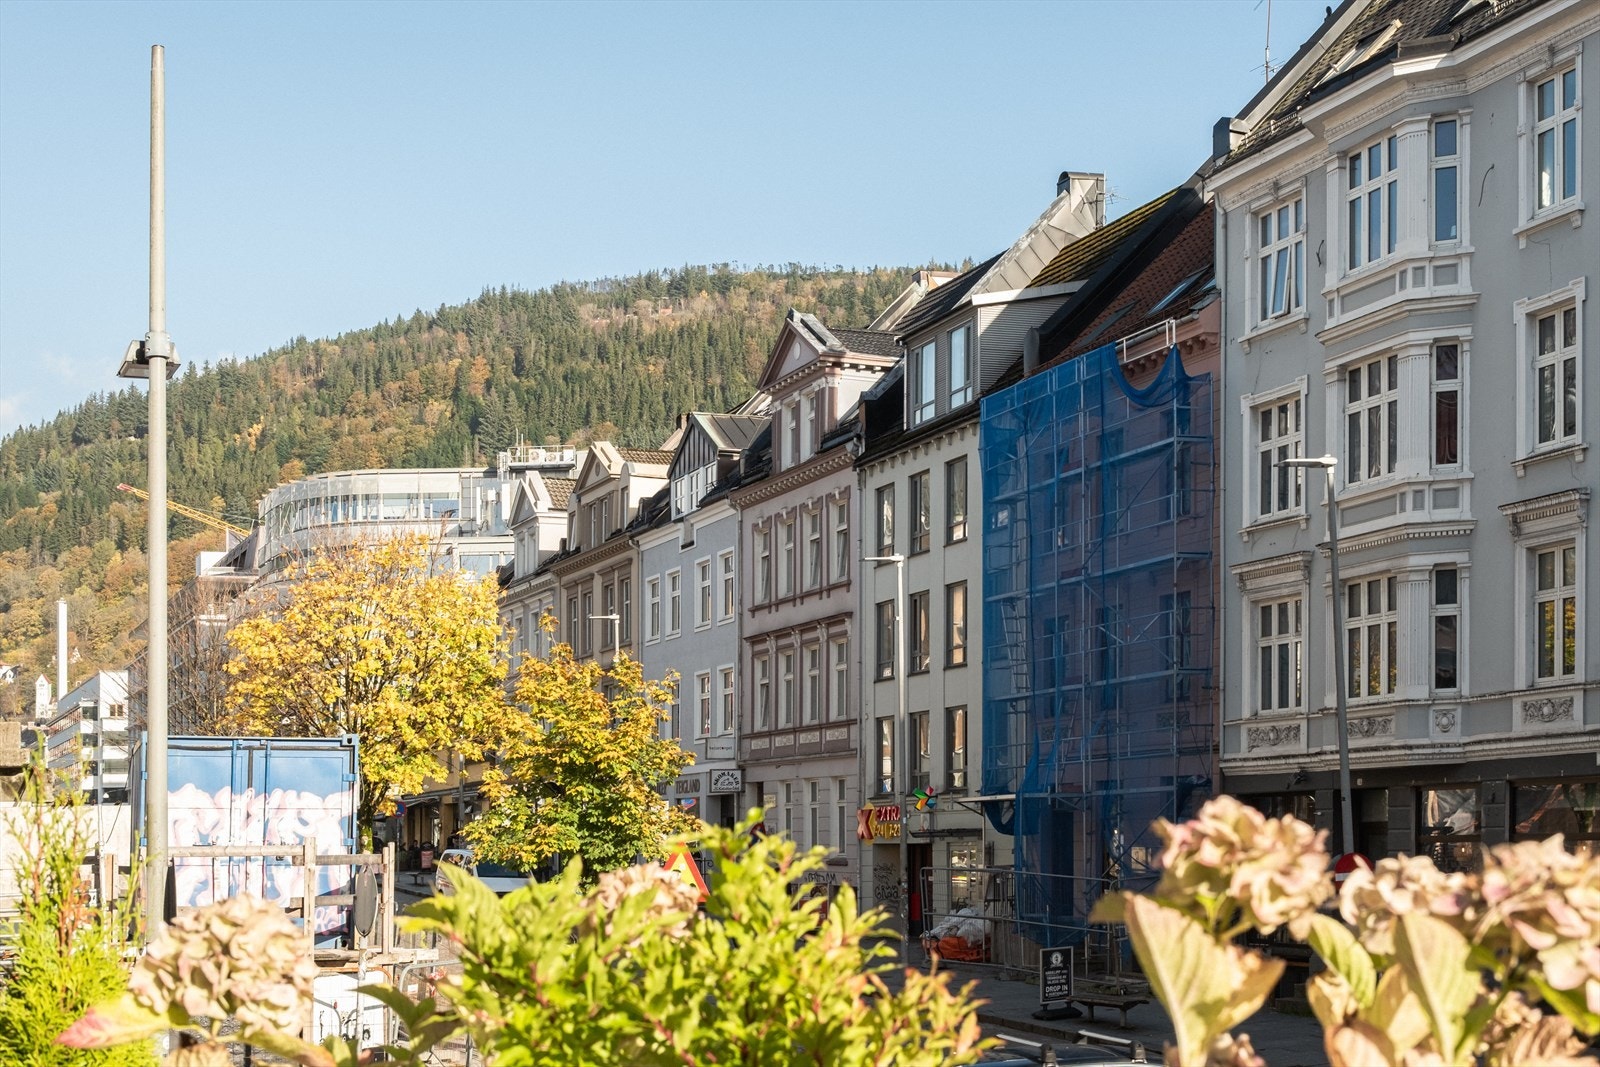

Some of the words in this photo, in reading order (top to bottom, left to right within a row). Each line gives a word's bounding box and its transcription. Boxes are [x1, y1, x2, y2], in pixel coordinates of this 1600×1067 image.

[675, 778, 700, 794] TEIGLAND
[713, 771, 740, 786] SKOMAKER
[1045, 985, 1061, 993] DROP
